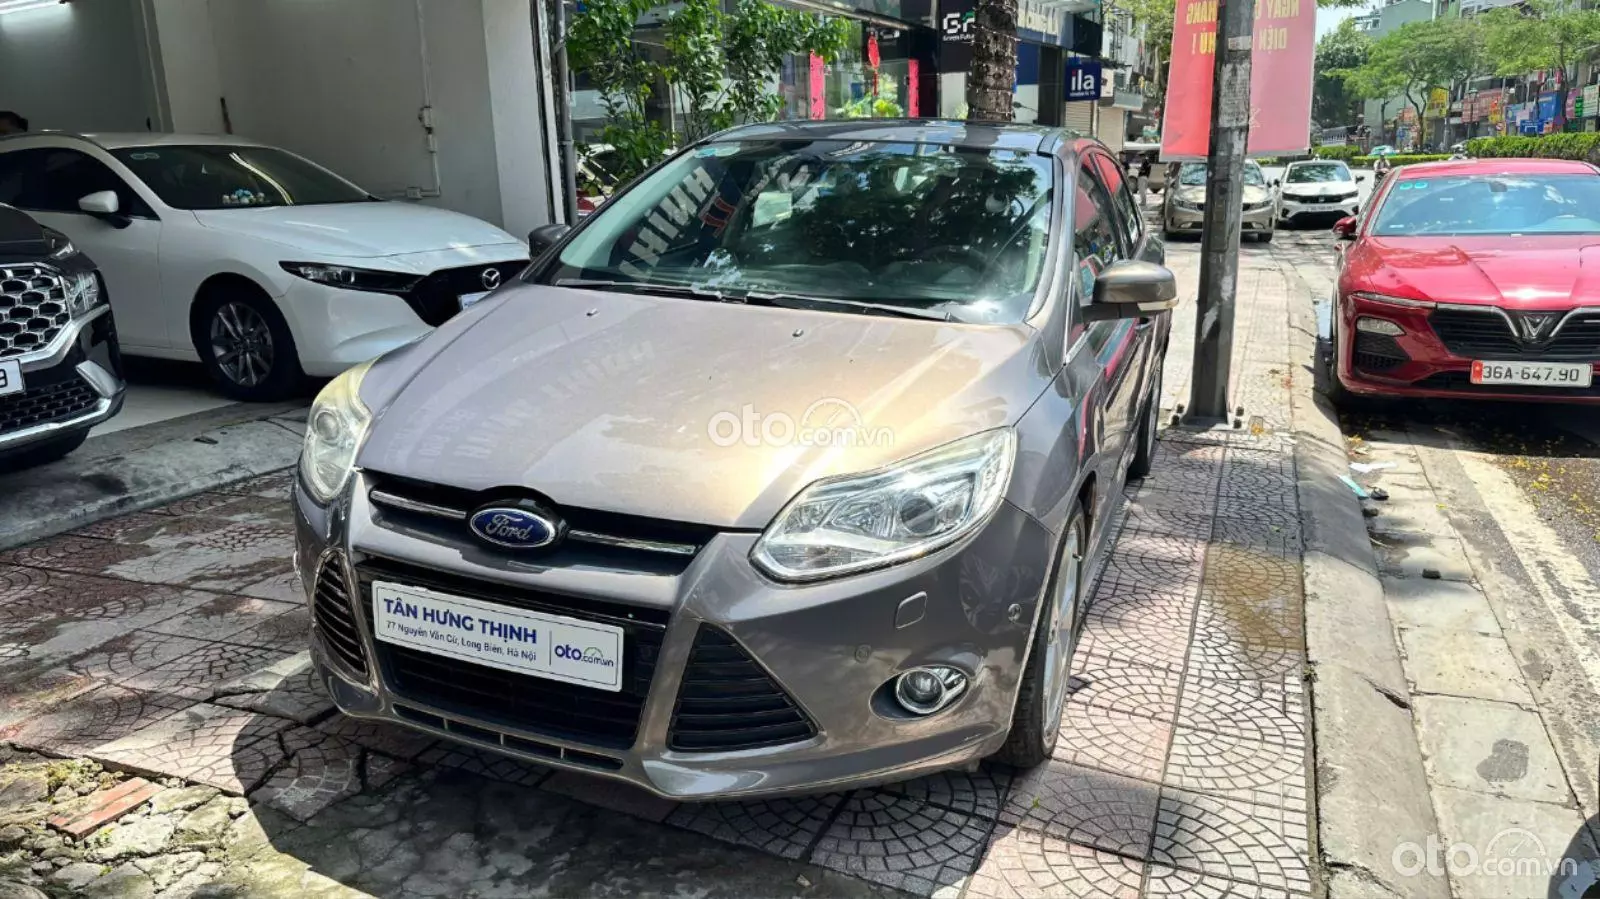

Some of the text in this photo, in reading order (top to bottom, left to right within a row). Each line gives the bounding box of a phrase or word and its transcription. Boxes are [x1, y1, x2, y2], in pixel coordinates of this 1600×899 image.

[1070, 68, 1095, 91] ila
[1483, 365, 1580, 382] 36A-647.90
[485, 514, 534, 540] Ford
[384, 597, 537, 644] TÂN HƯNG THỊNH
[387, 620, 396, 630] 77
[461, 637, 482, 652] Long
